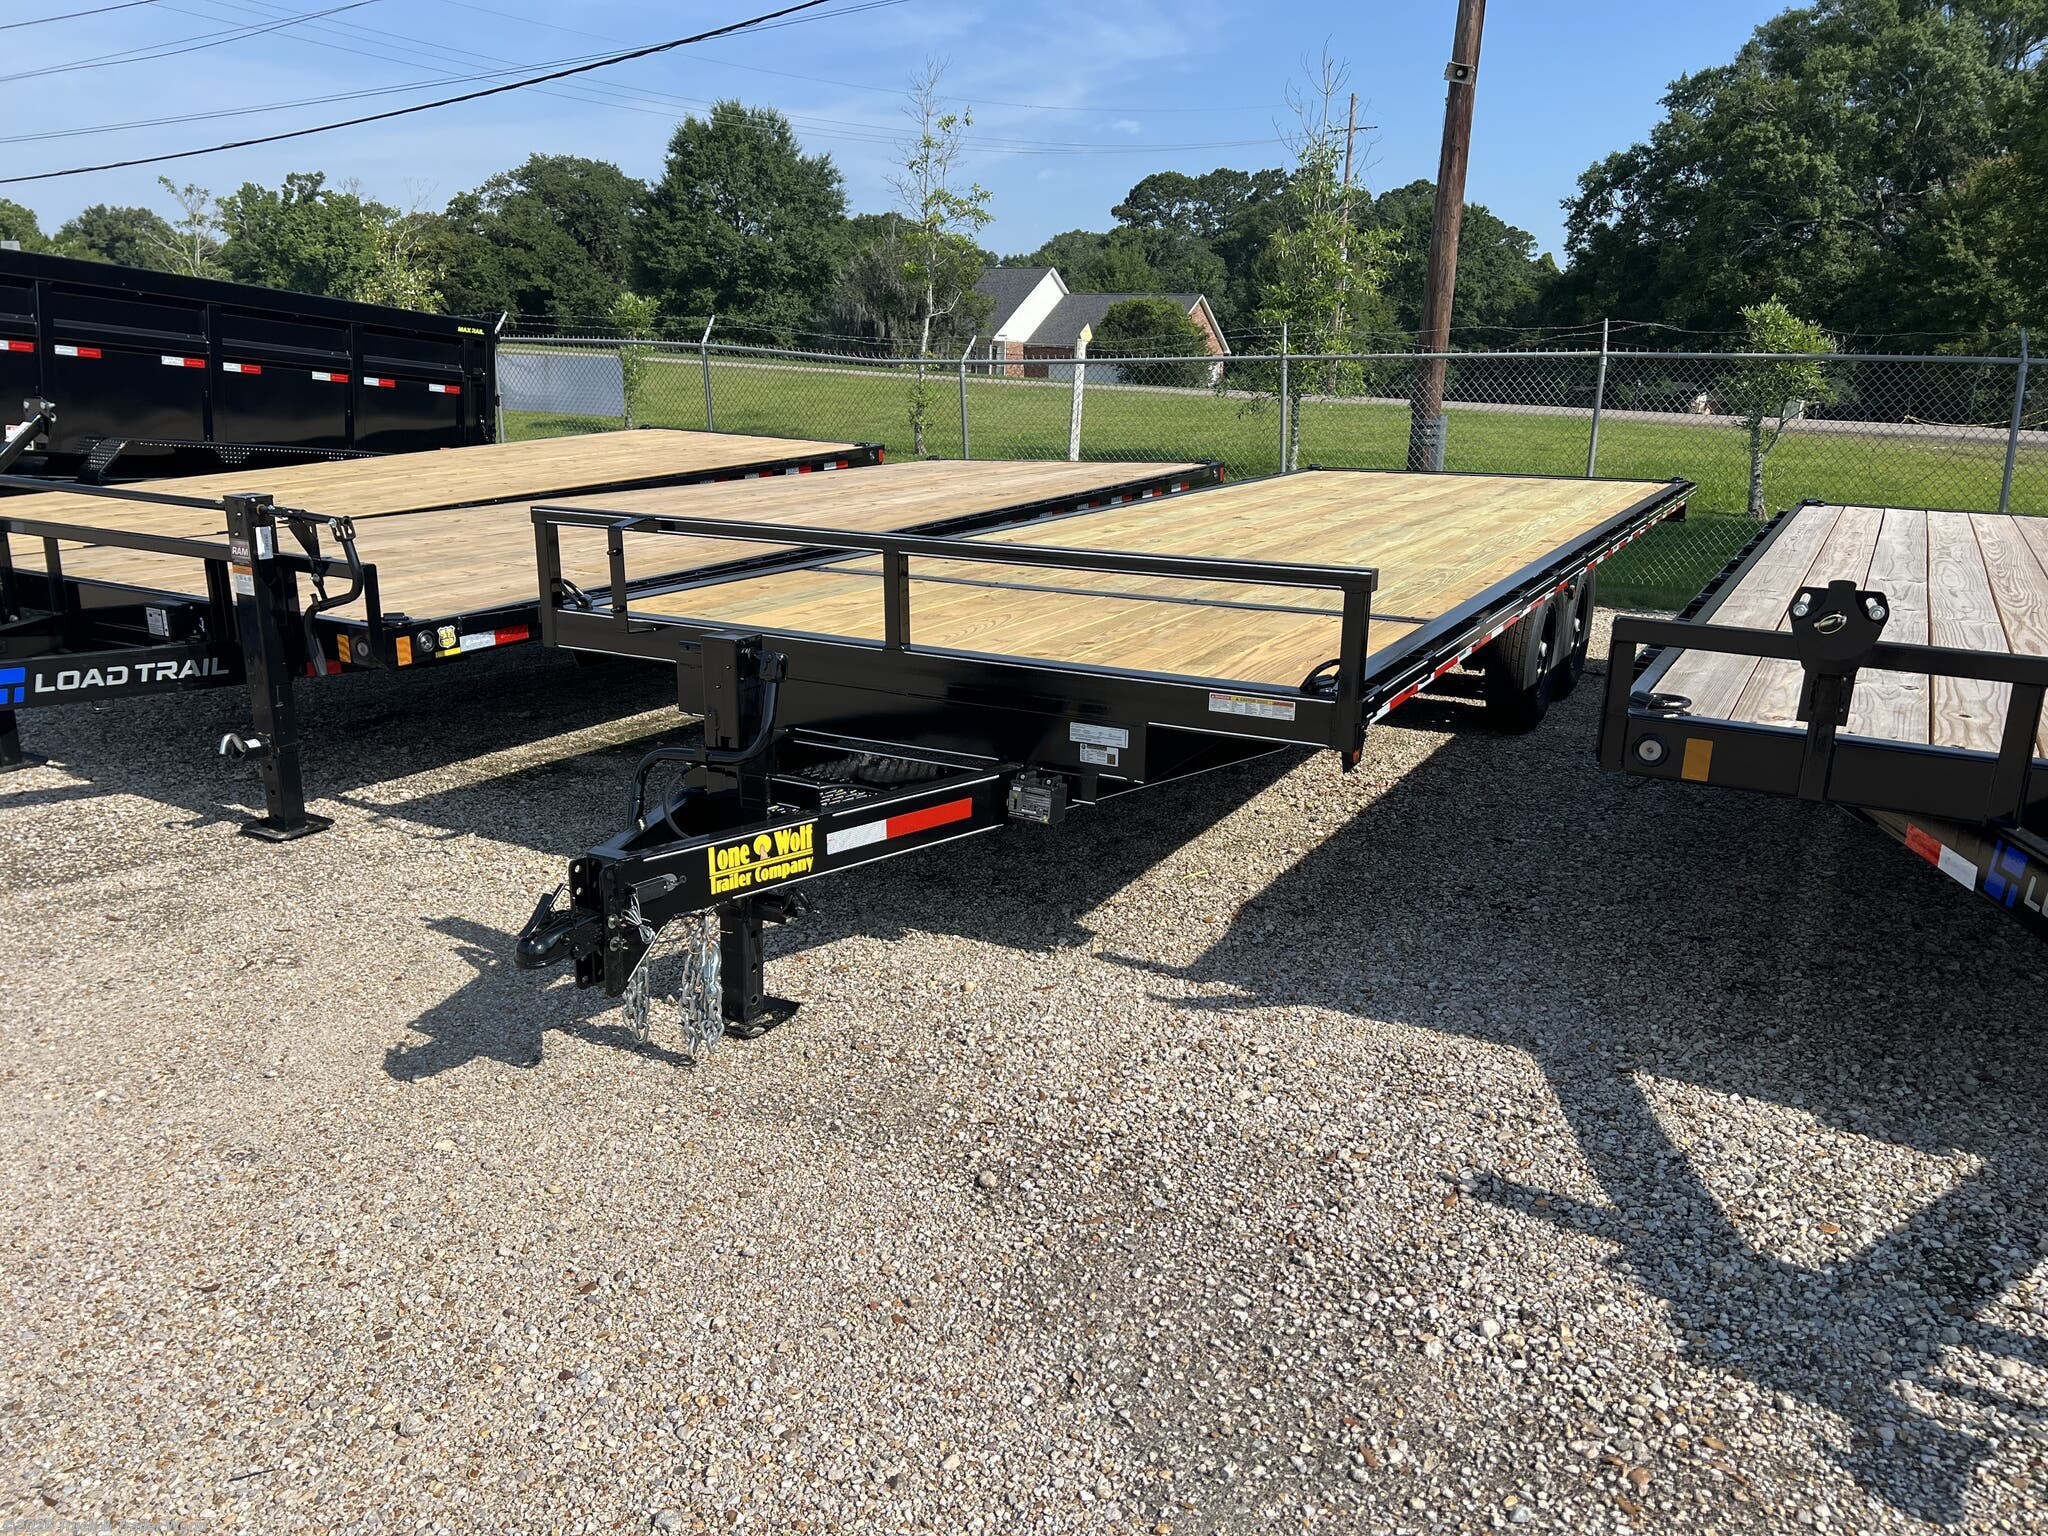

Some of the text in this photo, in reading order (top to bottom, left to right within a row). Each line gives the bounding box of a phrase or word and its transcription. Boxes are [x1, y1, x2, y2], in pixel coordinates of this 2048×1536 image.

[231, 546, 249, 557] RAM
[34, 657, 230, 693] LOAD TRAIL
[707, 823, 813, 876] Lone Wolf
[710, 856, 814, 895] Trailer Company
